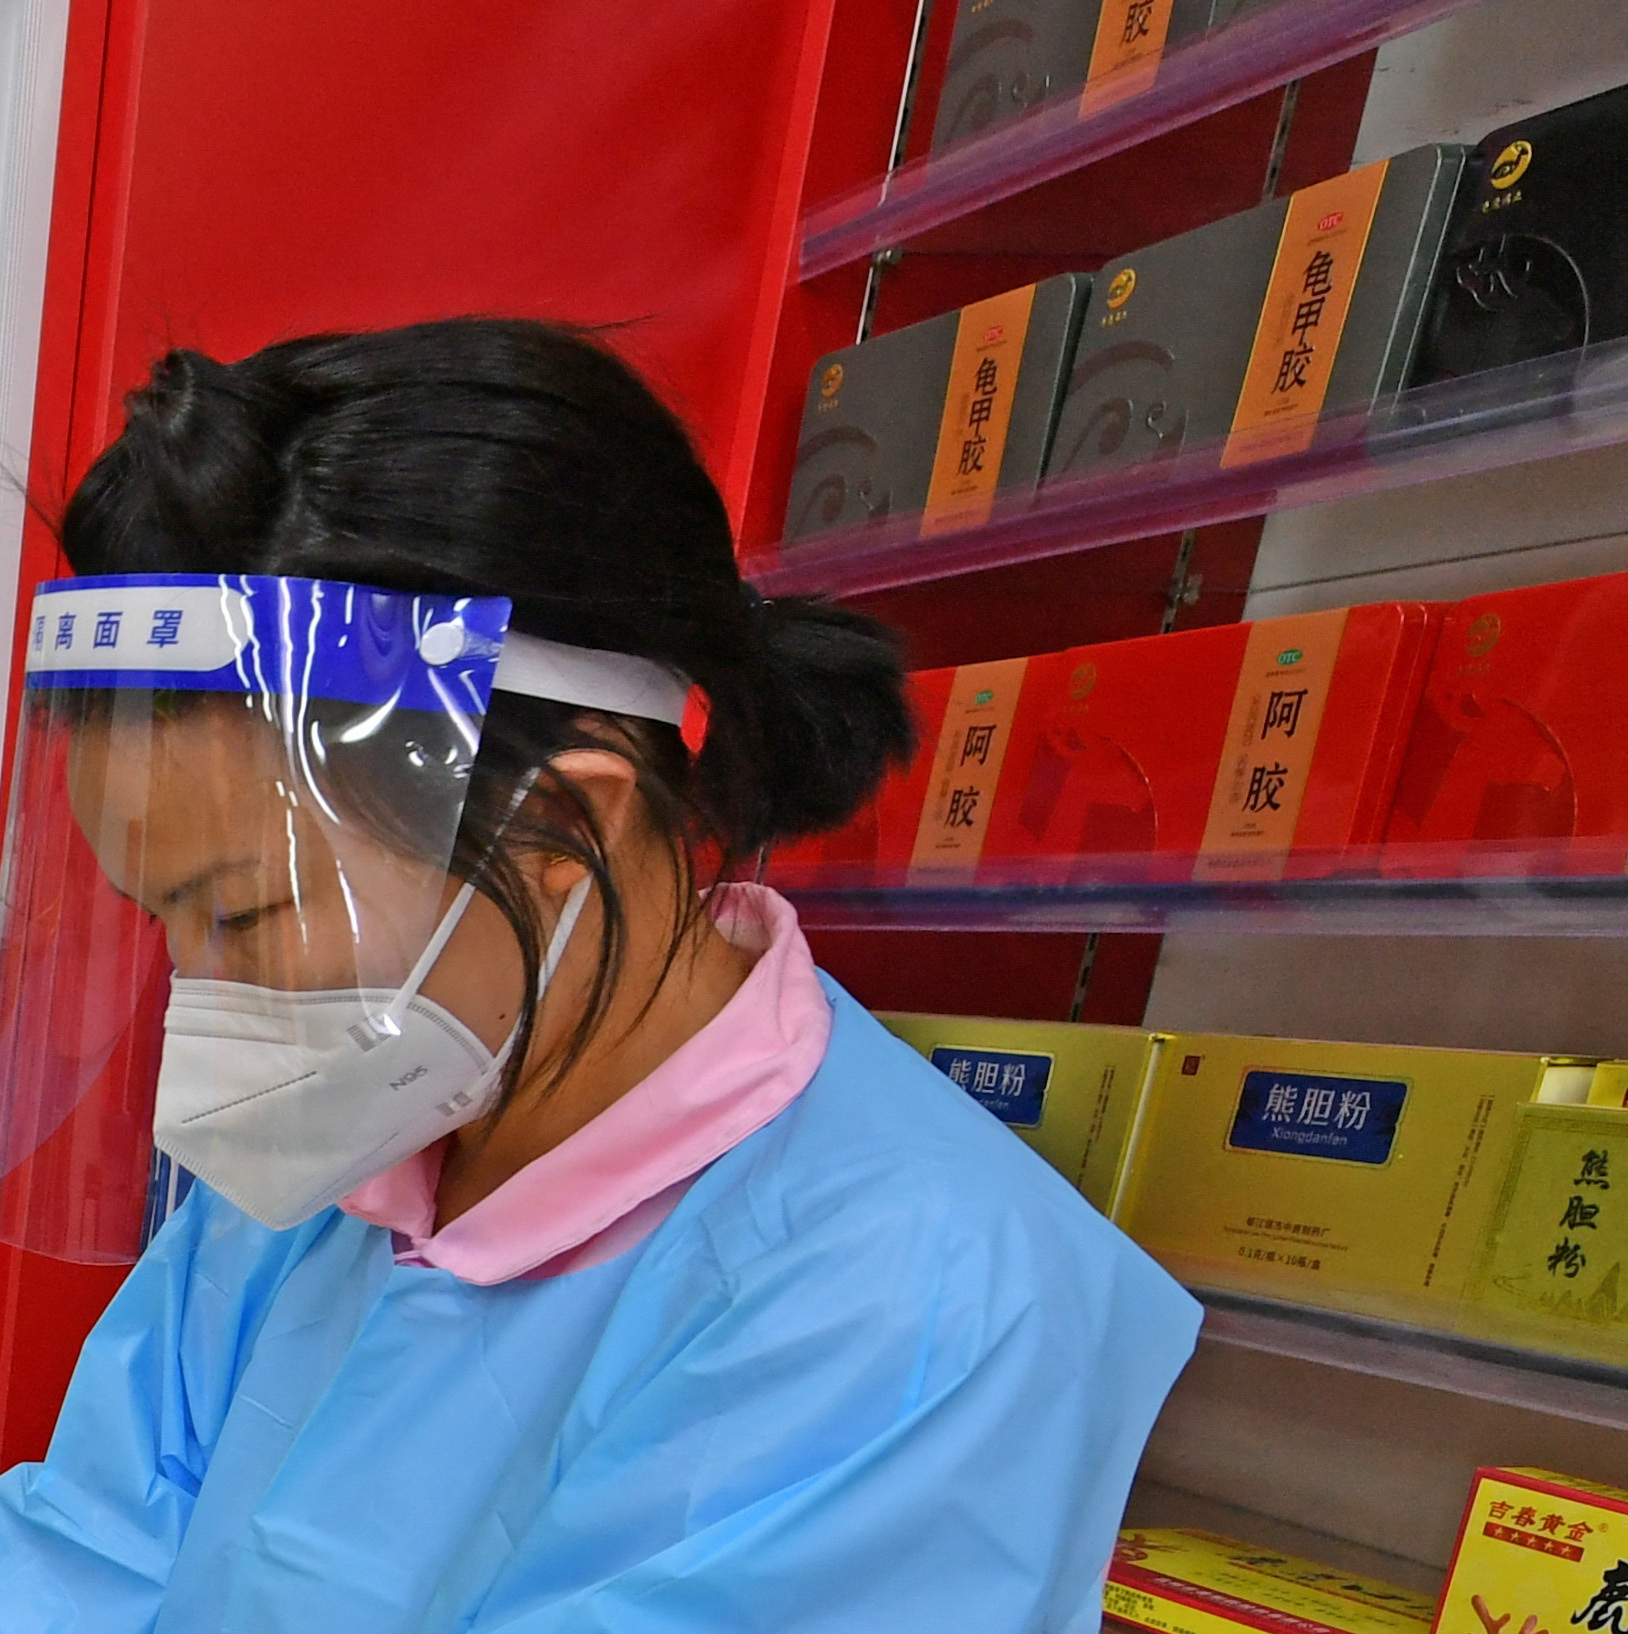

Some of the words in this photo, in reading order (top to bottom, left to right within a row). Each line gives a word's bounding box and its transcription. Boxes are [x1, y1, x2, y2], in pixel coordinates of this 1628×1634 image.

[1122, 1, 1153, 45] 胶
[1317, 213, 1344, 231] OTC
[1270, 250, 1334, 395] 龟甲胶
[957, 357, 998, 477] 龟甲胶
[1278, 650, 1303, 666] OTC
[1241, 688, 1308, 815] 阿胶
[944, 724, 997, 830] 阿胶
[389, 1065, 429, 1092] N95
[948, 1057, 1028, 1098] 熊胆粉
[1261, 1082, 1371, 1132] 熊胆粉
[1271, 1125, 1349, 1148] Xiongdanfen
[1547, 1149, 1612, 1279] 熊胆粉
[1486, 1499, 1595, 1546] 吉春黄金
